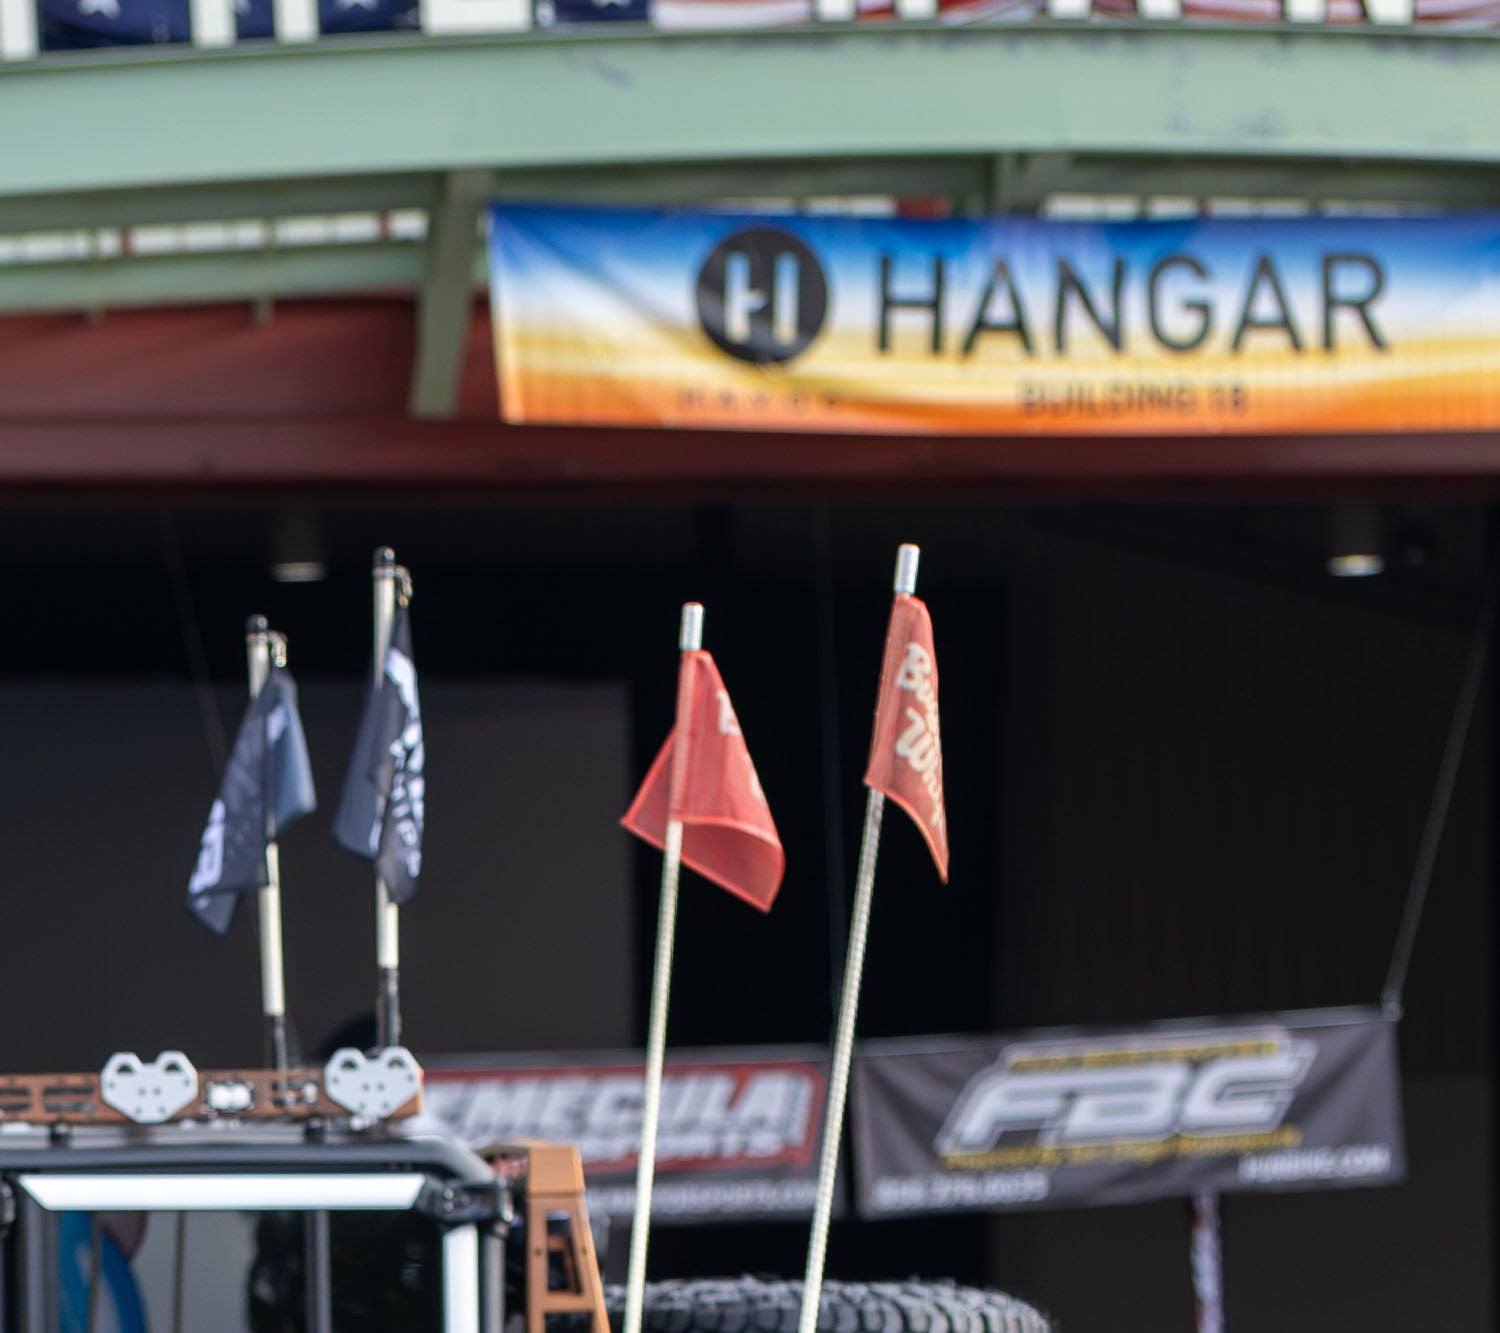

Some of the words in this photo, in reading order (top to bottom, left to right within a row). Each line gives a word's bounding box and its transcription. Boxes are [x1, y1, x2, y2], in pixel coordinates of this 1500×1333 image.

[877, 250, 1391, 356] HANGAR
[414, 1073, 812, 1145] EMECULA
[942, 1042, 1312, 1152] FBC
